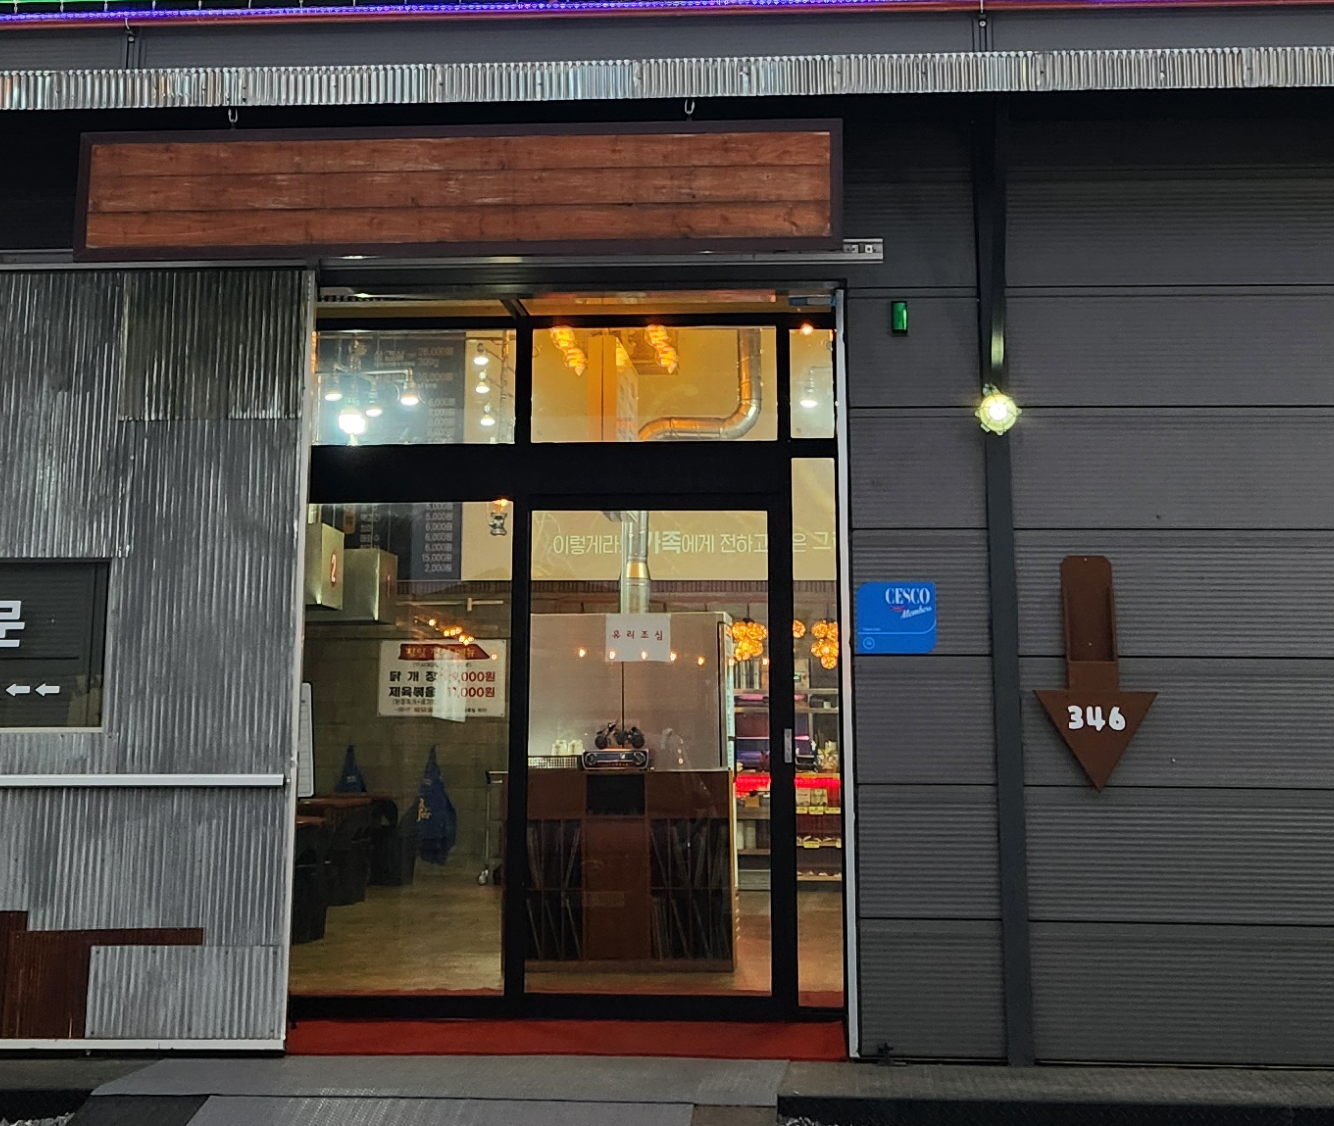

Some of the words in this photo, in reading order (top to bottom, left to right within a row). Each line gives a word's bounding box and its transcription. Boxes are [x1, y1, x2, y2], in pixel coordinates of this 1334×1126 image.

[553, 535, 621, 555] 이렇게라
[885, 587, 931, 605] CESCO
[1067, 705, 1126, 732] 346
